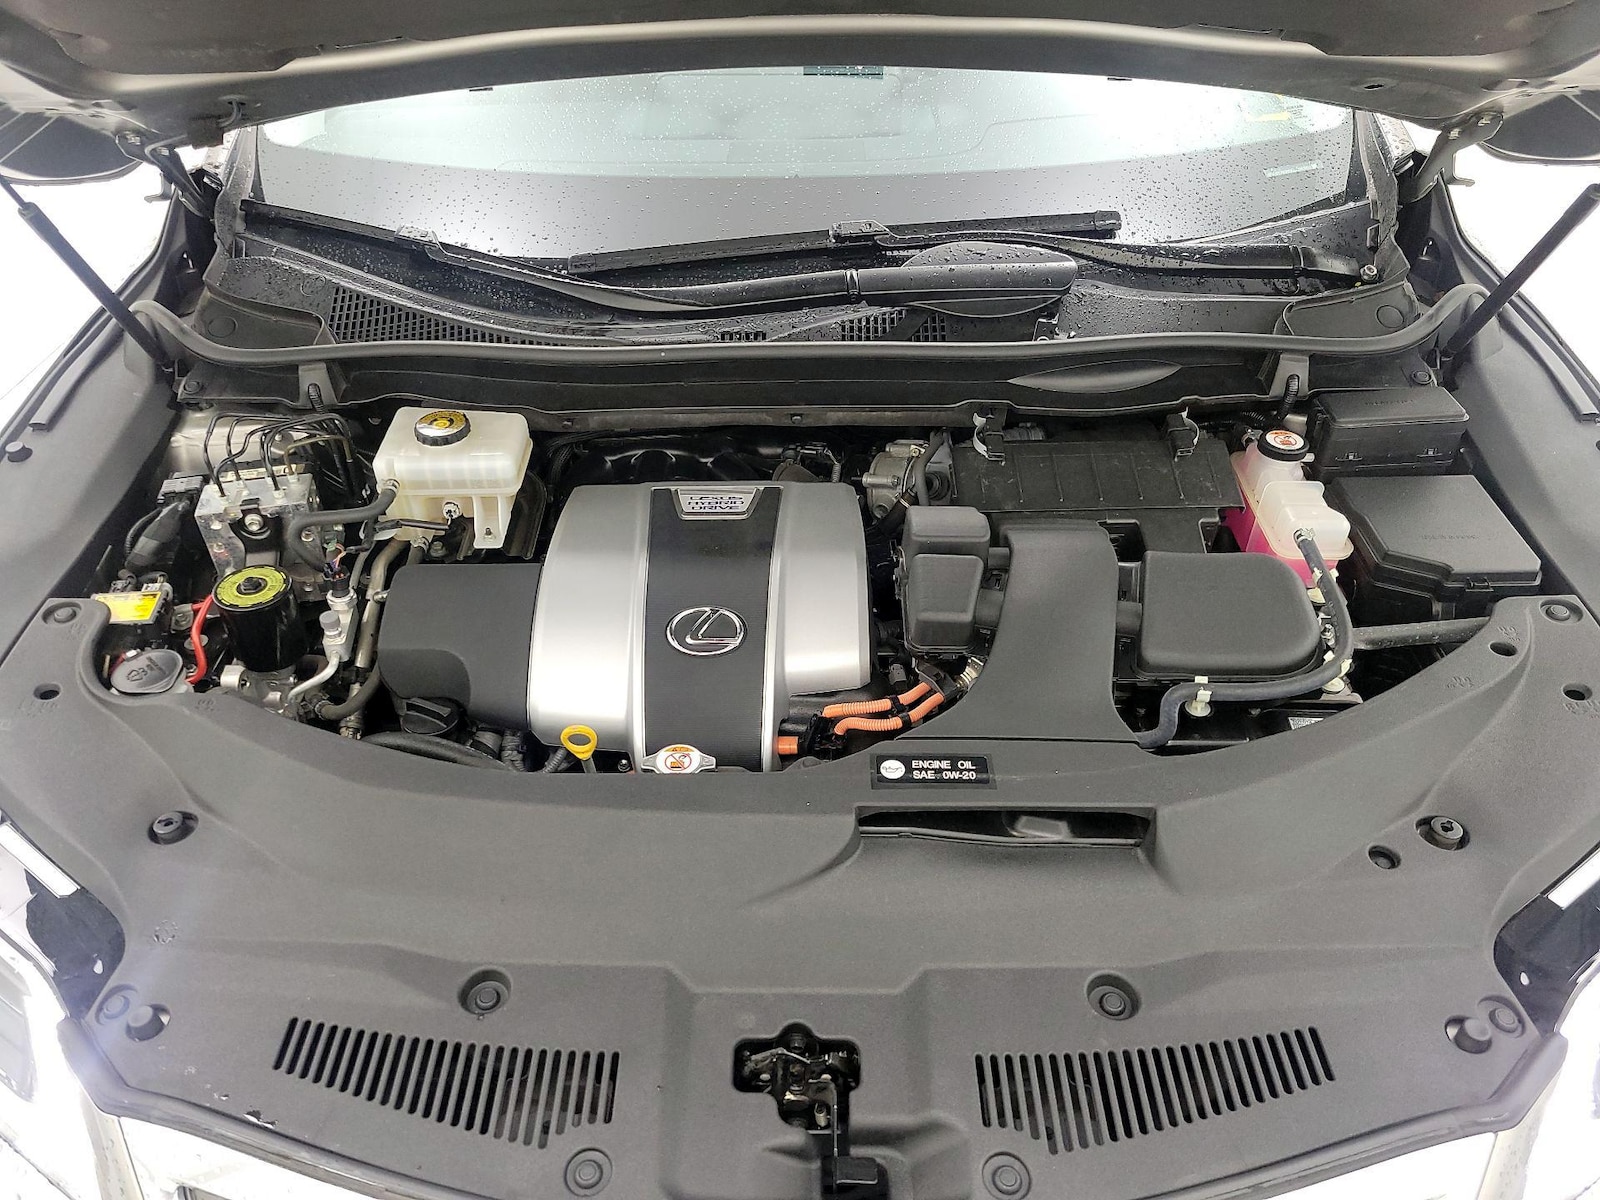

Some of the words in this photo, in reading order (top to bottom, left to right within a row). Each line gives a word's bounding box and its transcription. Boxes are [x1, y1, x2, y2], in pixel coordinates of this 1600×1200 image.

[911, 760, 951, 769] ENGINE
[957, 760, 976, 769] OIL
[942, 770, 977, 780] 0W-20
